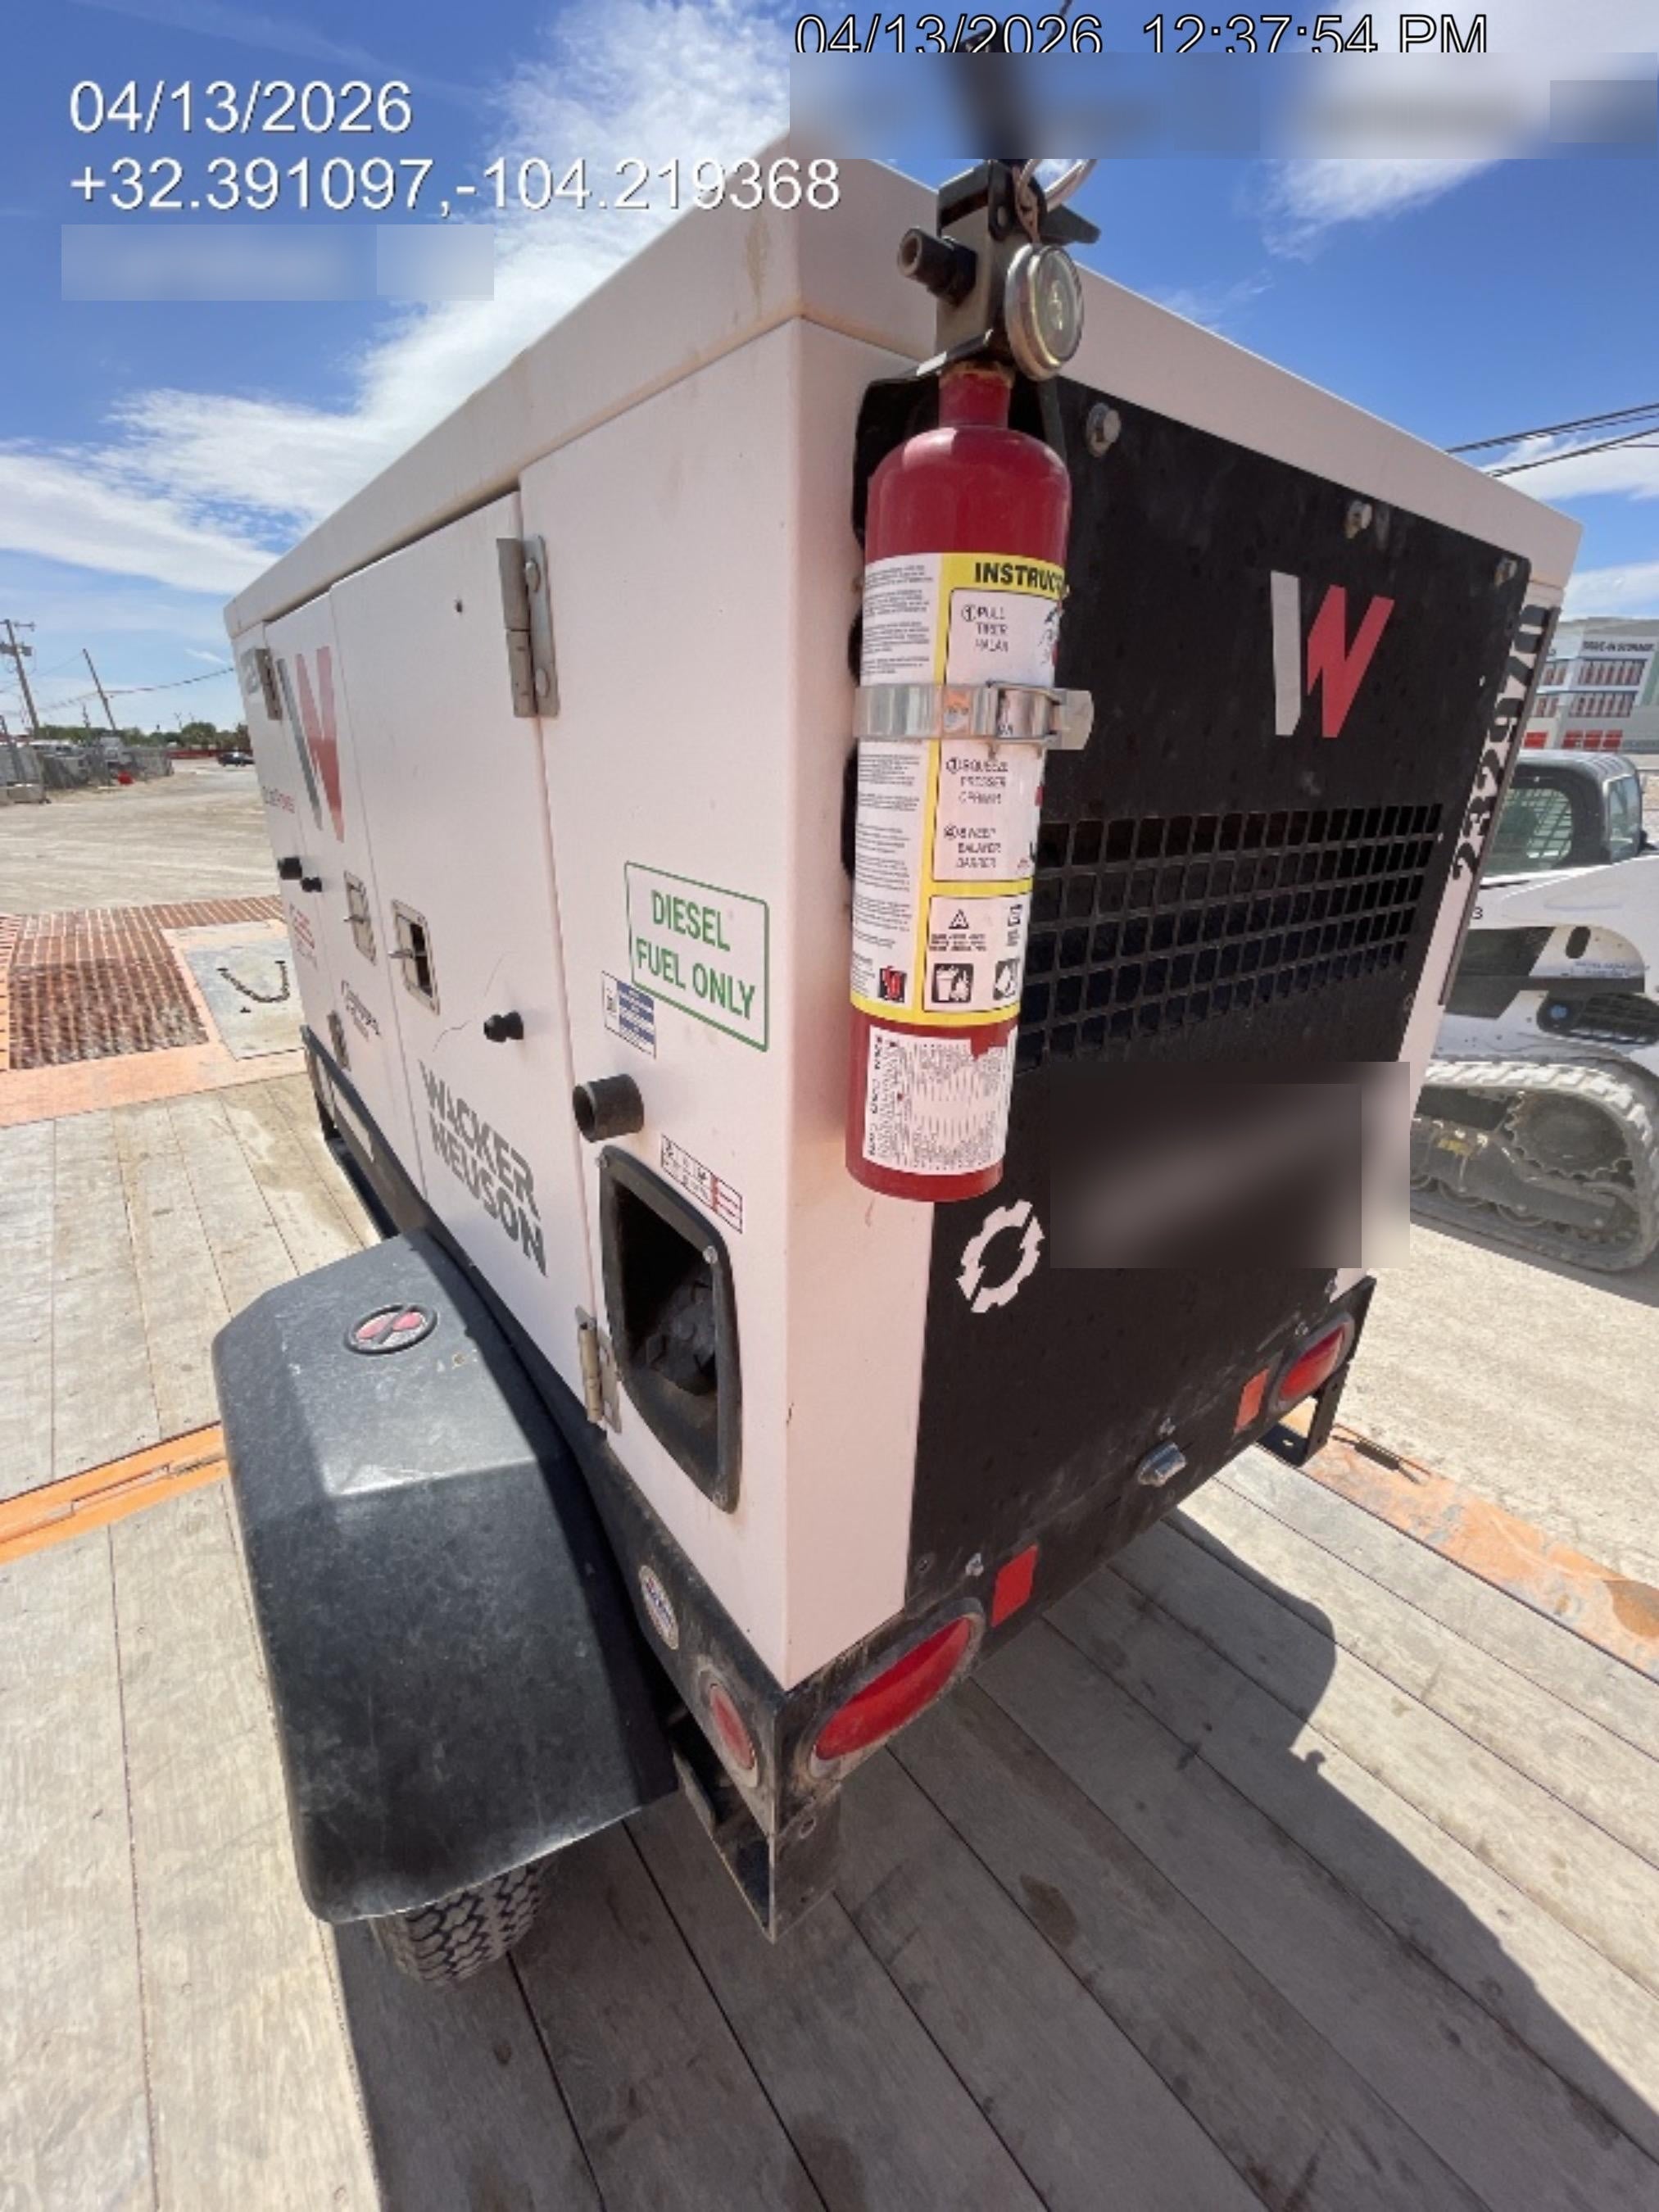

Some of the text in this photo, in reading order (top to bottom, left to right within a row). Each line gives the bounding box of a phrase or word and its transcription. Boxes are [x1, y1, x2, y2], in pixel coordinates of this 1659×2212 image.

[636, 936, 687, 990] FUEL
[692, 962, 755, 1021] ONLY
[651, 889, 731, 952] DIESEL
[418, 1058, 541, 1222] WACKER
[429, 1111, 548, 1278] NEUSON
